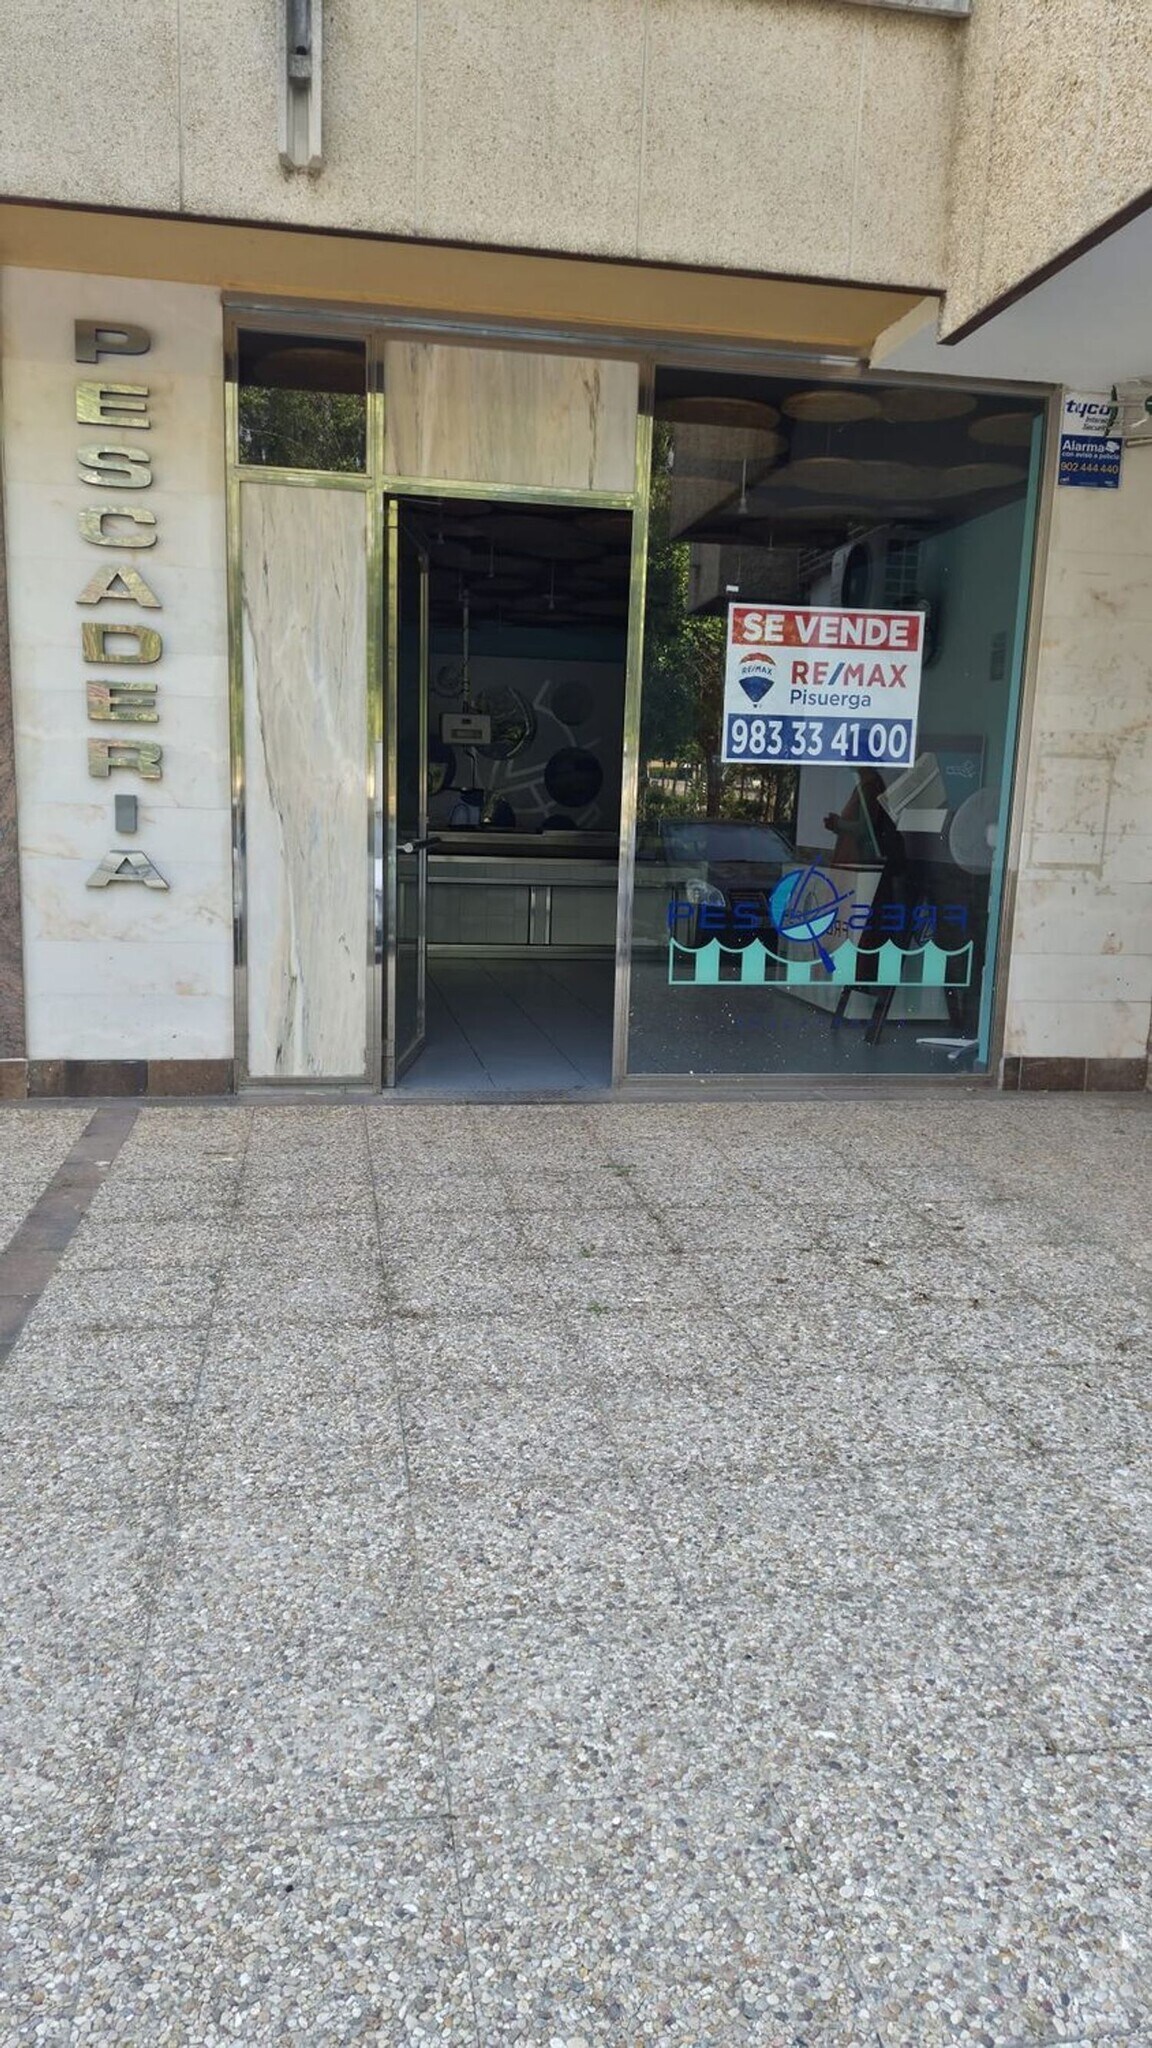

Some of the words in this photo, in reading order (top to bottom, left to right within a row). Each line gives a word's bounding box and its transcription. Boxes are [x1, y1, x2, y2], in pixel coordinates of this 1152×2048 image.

[1066, 400, 1112, 417] tyco
[1062, 440, 1105, 453] Alarma
[75, 318, 170, 893] PESCADERIA
[742, 613, 785, 643] SE
[794, 615, 910, 647] VENDE
[741, 664, 773, 676] RE/MAX
[791, 660, 908, 688] RE/MAX
[790, 689, 872, 710] Pisuerga
[731, 719, 783, 755] 983
[791, 721, 823, 756] 33
[830, 723, 860, 757] 41
[868, 723, 908, 759] 00
